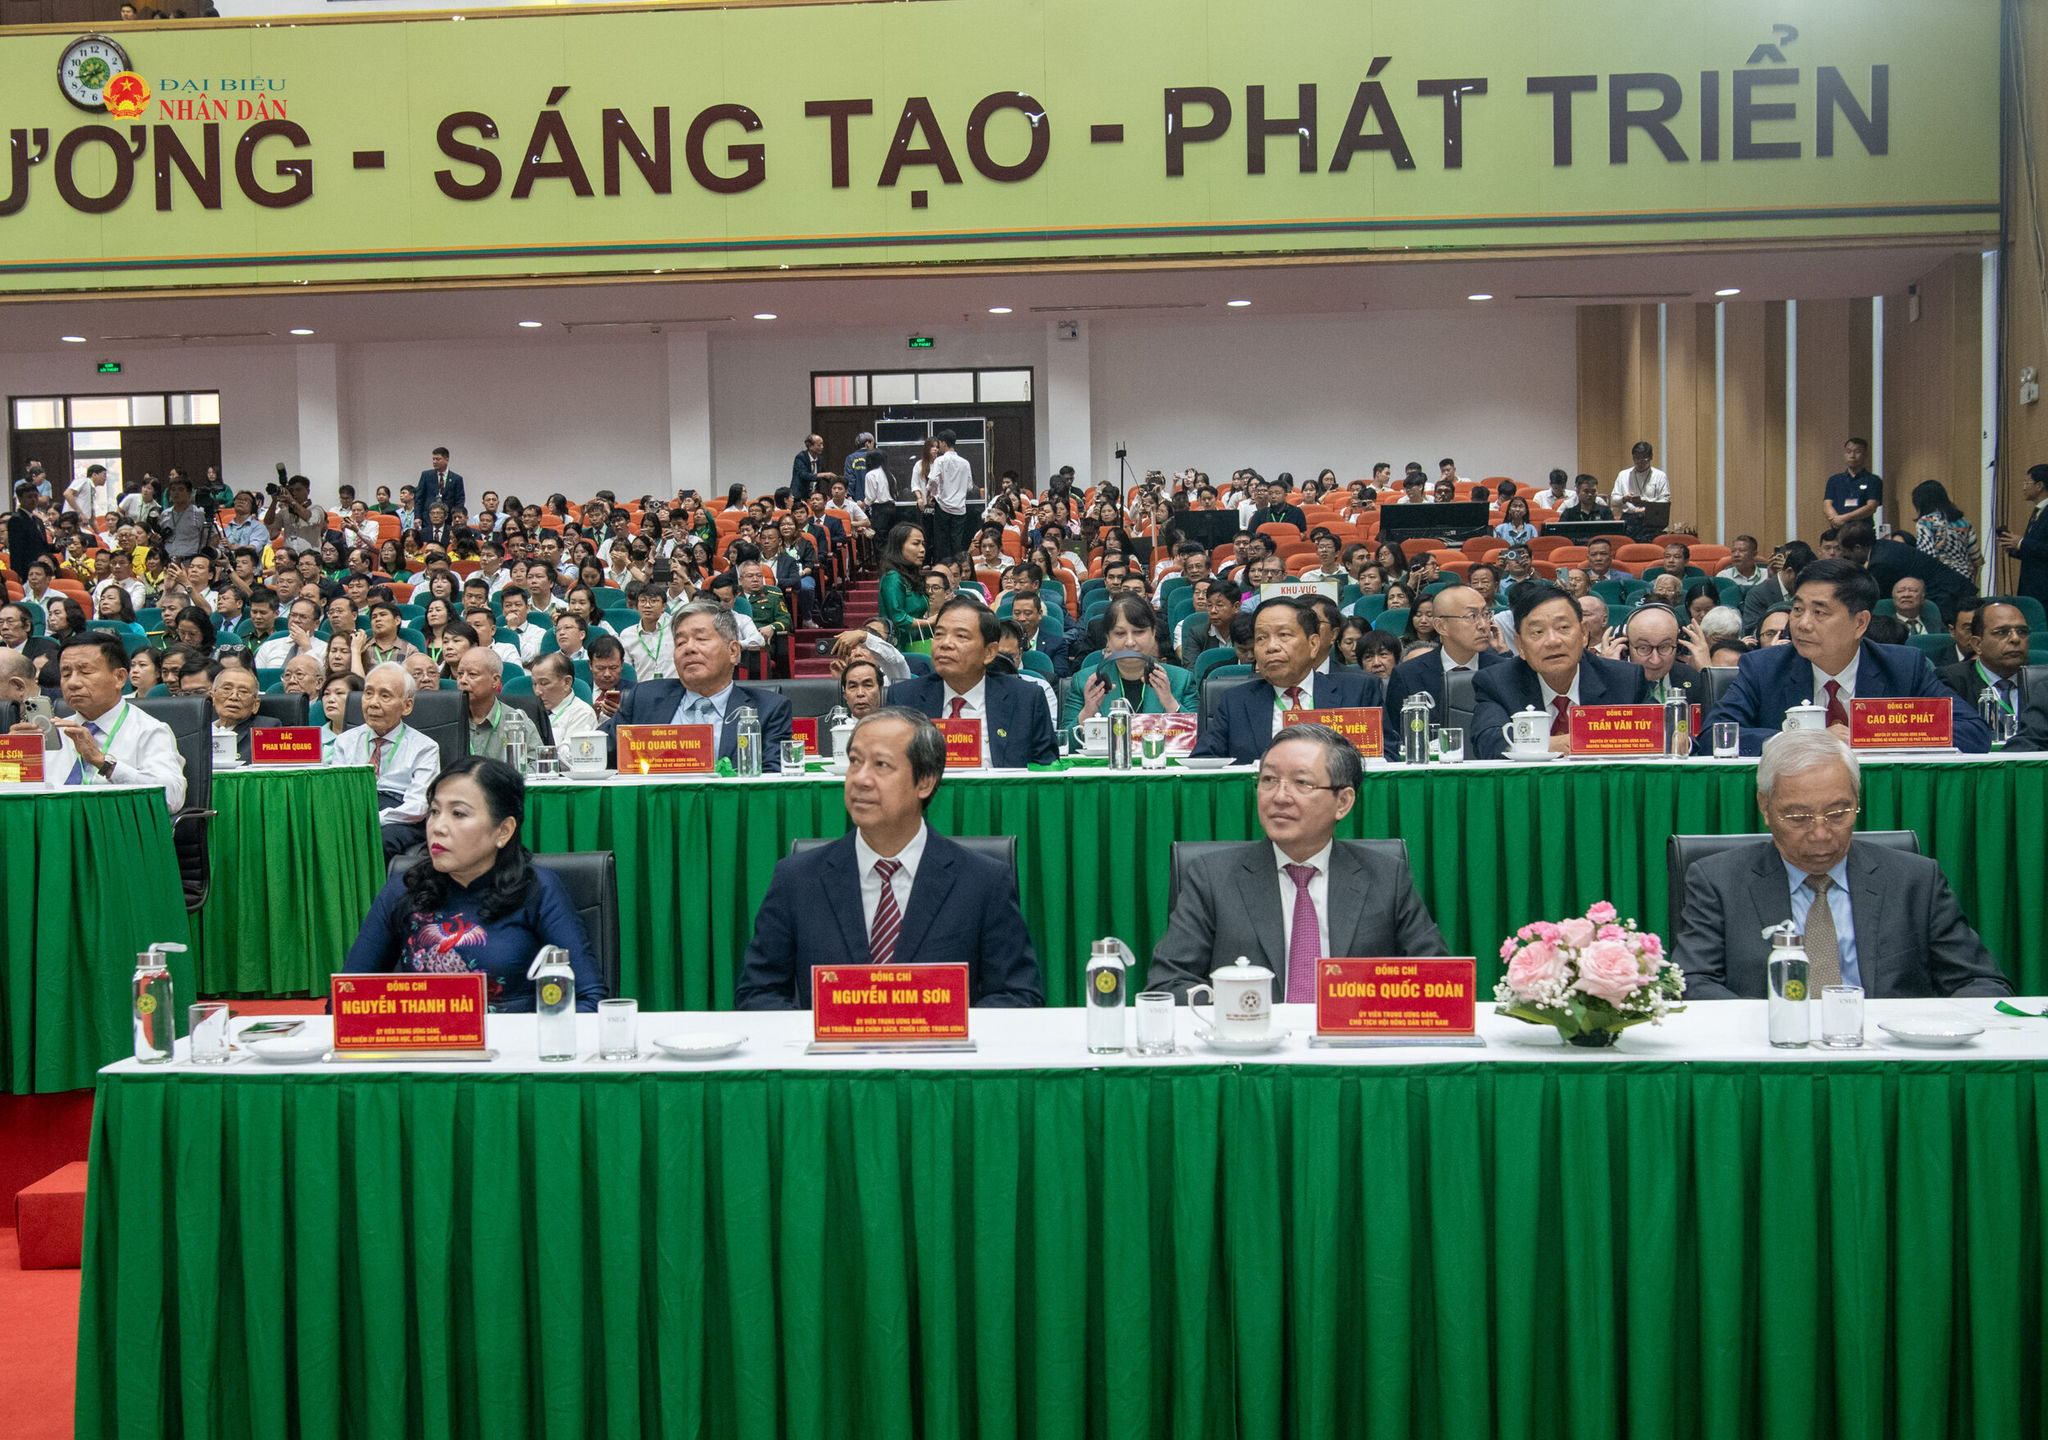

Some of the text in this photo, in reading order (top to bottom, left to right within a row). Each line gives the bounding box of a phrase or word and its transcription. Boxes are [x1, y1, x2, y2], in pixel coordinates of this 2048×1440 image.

[434, 86, 767, 201] SÁNG
[804, 91, 1051, 209] TẠO
[1164, 56, 1488, 178] PHÁT
[1526, 23, 1890, 167] TRIỂN
[1867, 711, 1935, 724] CAO ĐỨC PHÁT
[1345, 722, 1367, 734] VIÊN
[1588, 718, 1651, 731] TRẦN VĂN TÚY
[281, 732, 293, 740] BÁC
[947, 733, 973, 743] CƯỜNG
[262, 742, 312, 751] PHAN VĂN QUANG
[648, 740, 677, 750] QUANG
[679, 740, 701, 749] VINH
[6, 749, 23, 759] SƠN
[870, 970, 912, 982] ĐỒNG CHÍ
[1375, 964, 1417, 976] ĐỒNG CHÍ
[386, 980, 427, 992] ĐỒNG CHÍ
[1329, 979, 1464, 999] LƯƠNG QUỐC ĐOÀN
[832, 985, 950, 1004] NGUYỄN KIM SƠN
[342, 995, 473, 1014] NGUYỄN THANH HẢI
